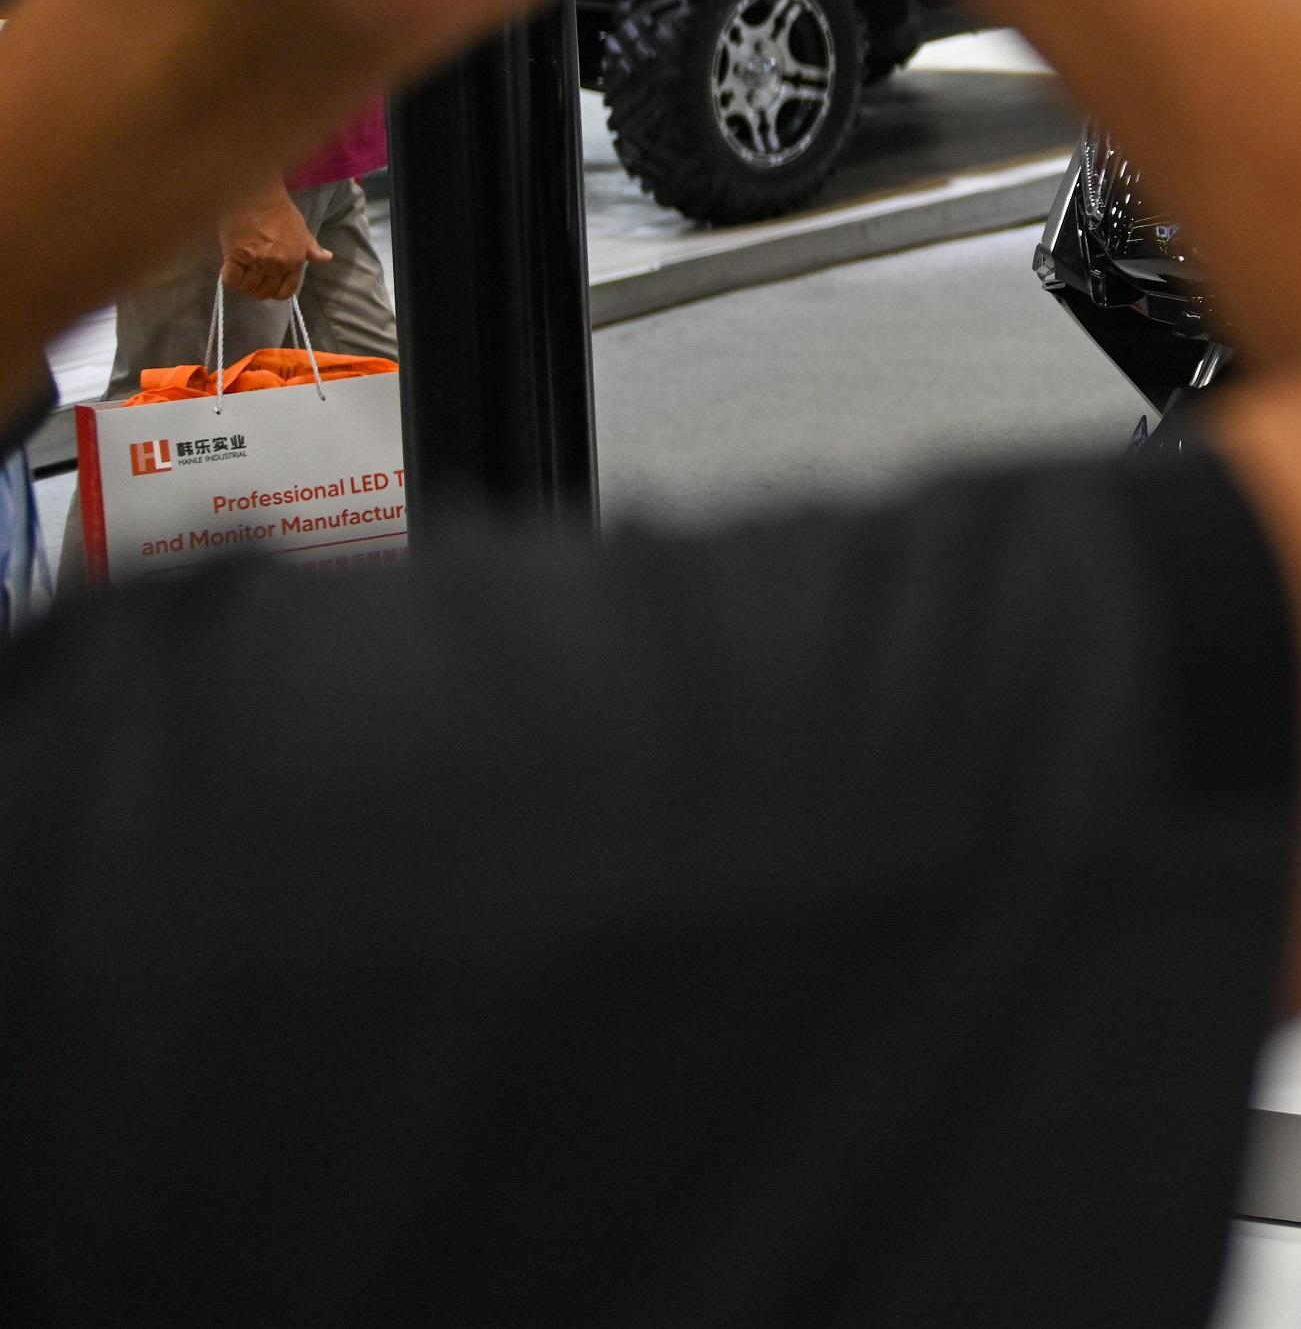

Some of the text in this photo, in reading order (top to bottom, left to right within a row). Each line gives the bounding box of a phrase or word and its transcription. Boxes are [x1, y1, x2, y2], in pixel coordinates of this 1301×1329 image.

[175, 434, 247, 458] 韩乐实业
[178, 450, 248, 467] HANLE INDUSTRIAL
[212, 468, 405, 514] Professional LED T
[140, 502, 408, 557] and Monitor Manufactur
